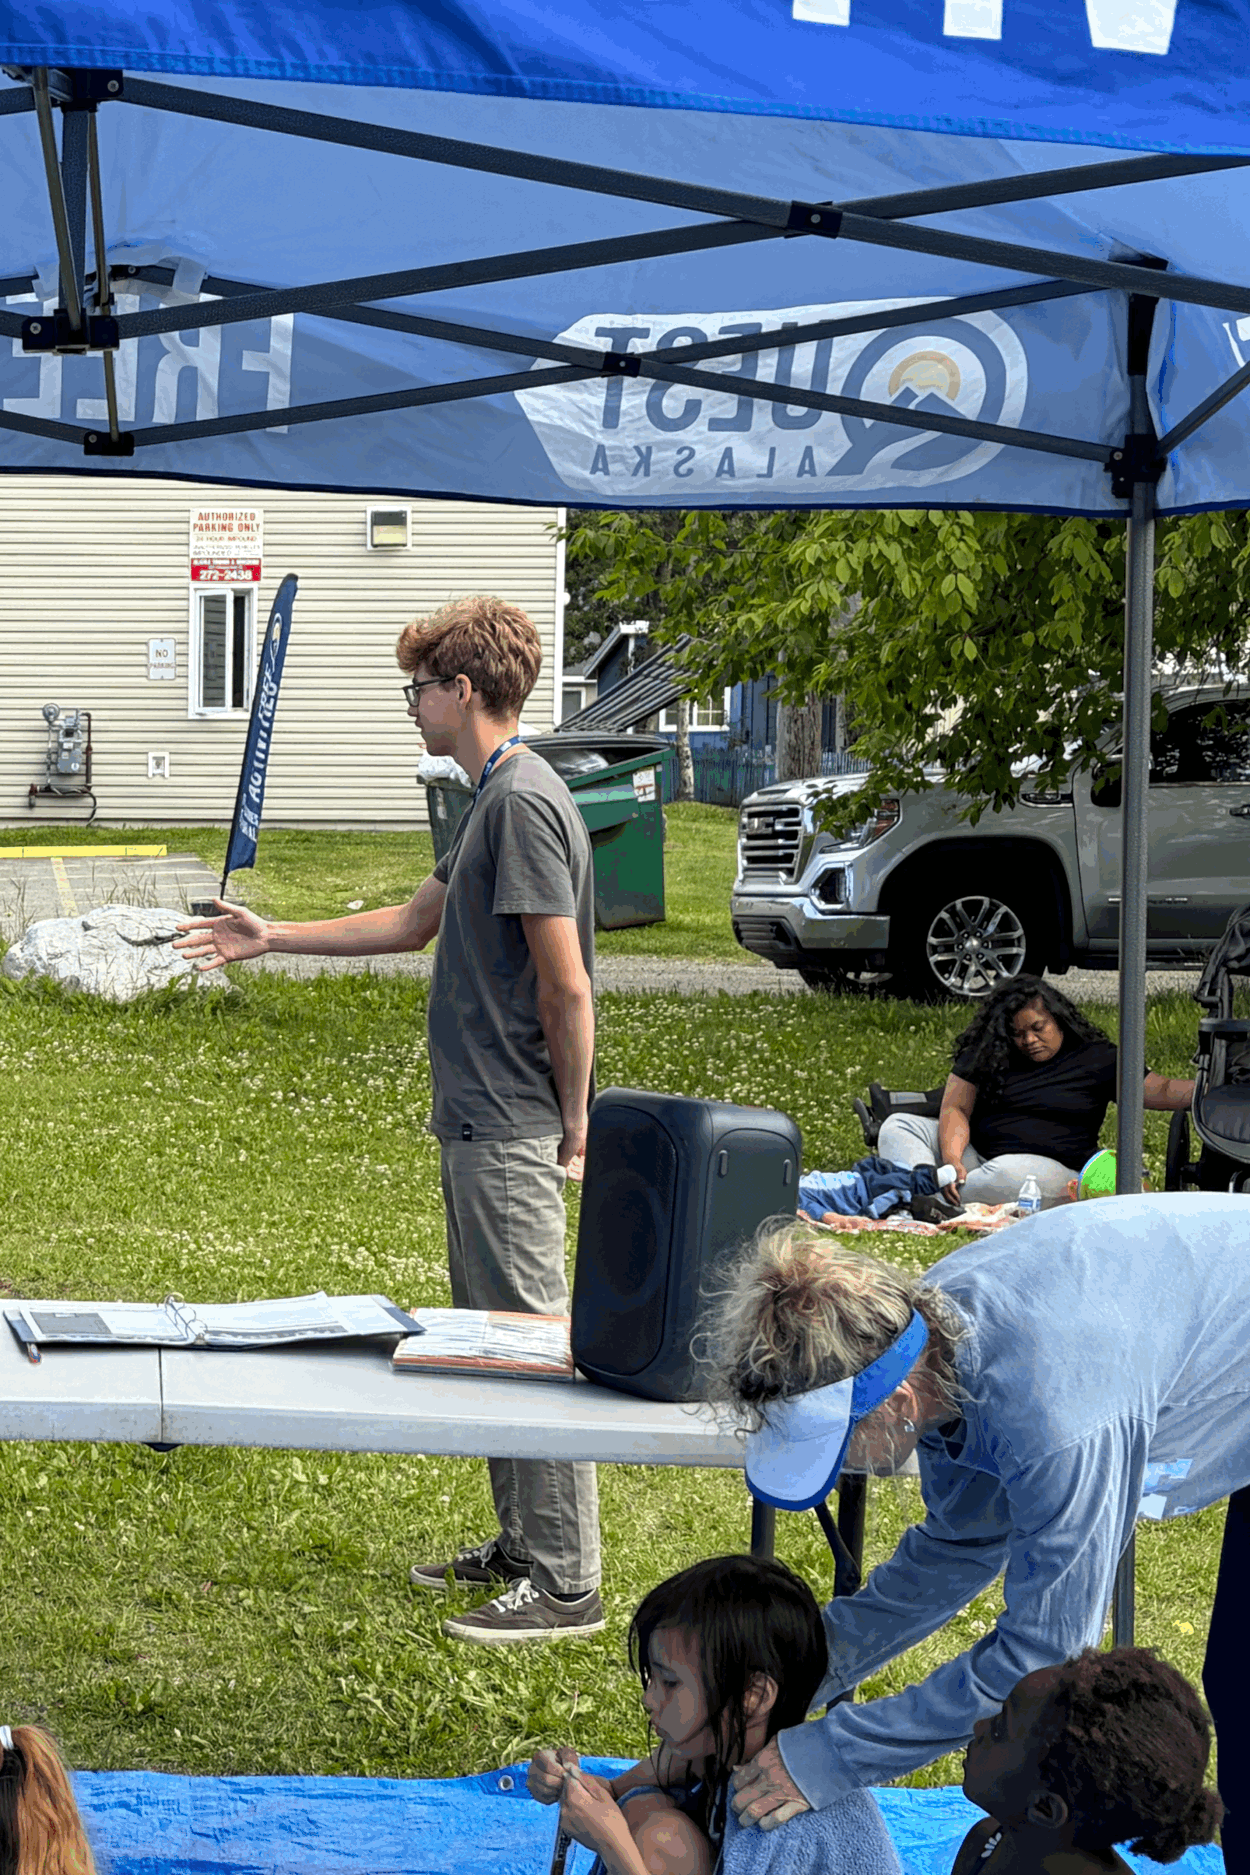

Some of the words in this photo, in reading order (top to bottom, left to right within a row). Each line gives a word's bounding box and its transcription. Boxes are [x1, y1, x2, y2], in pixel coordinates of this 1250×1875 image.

[197, 511, 256, 521] AUTHORIZED
[193, 522, 234, 532] PARKING
[237, 522, 261, 532] ONLY
[155, 648, 169, 658] NO
